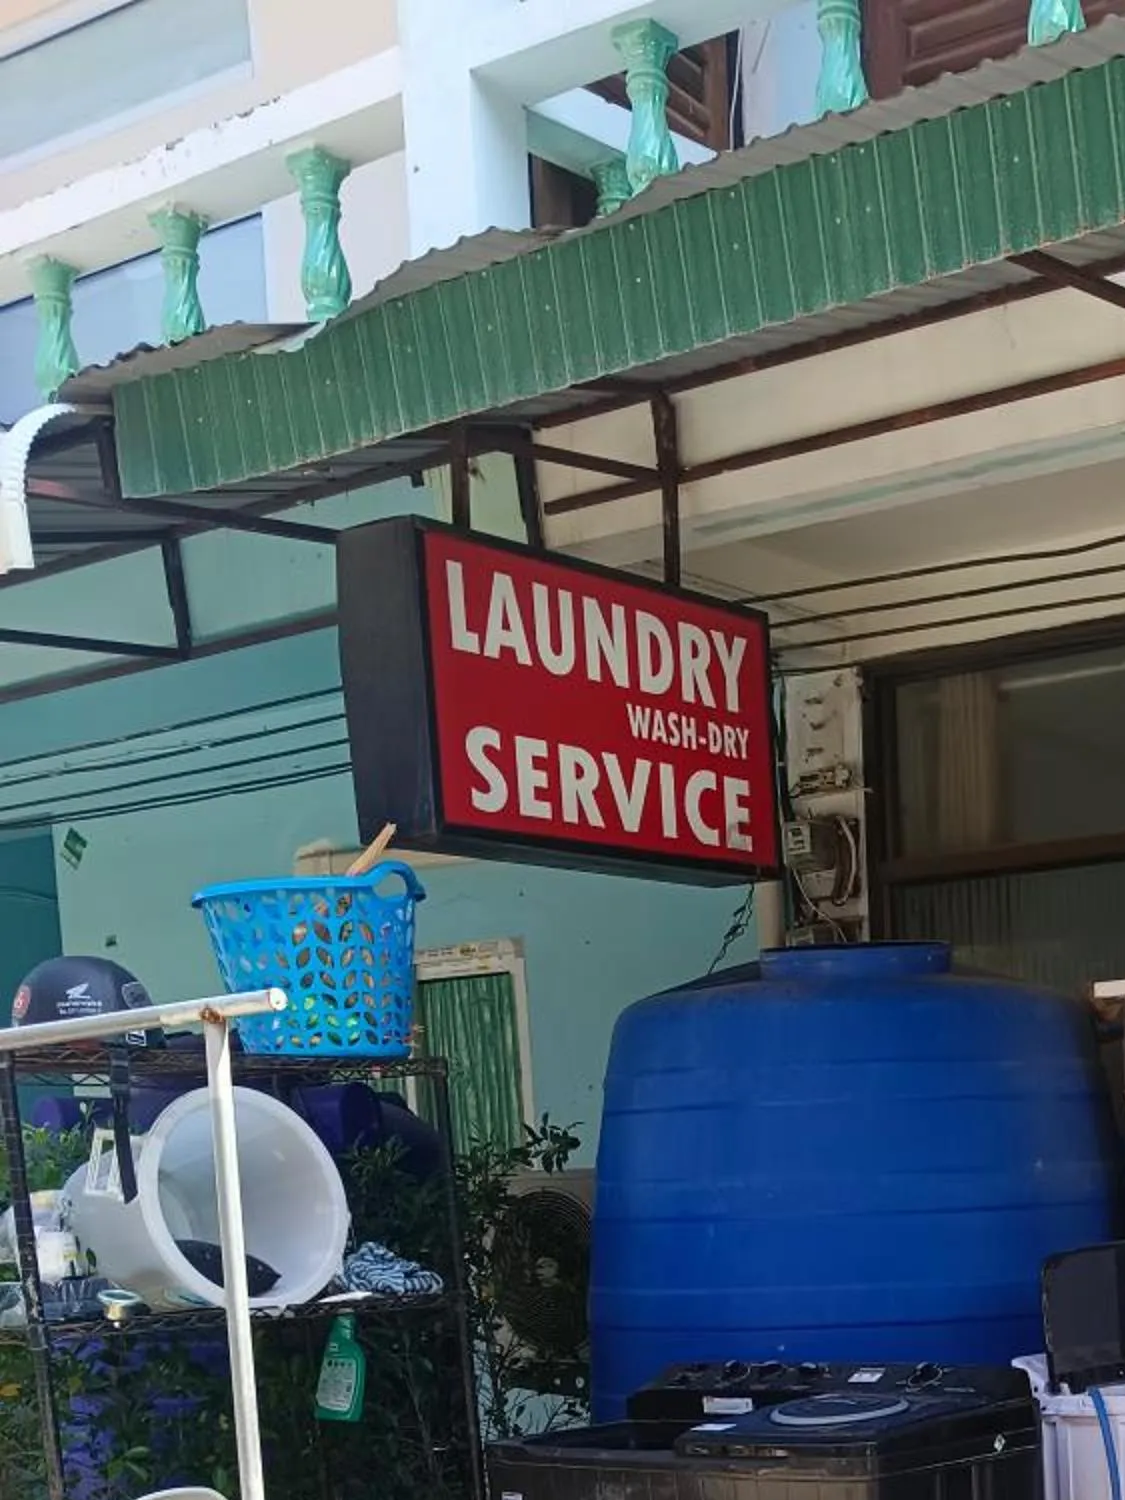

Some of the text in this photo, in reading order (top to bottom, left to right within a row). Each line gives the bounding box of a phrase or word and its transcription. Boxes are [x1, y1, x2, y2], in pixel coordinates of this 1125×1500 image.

[445, 559, 747, 714] LAUNDRY
[464, 725, 753, 853] SERVICE
[626, 702, 750, 760] WASH-DRY
